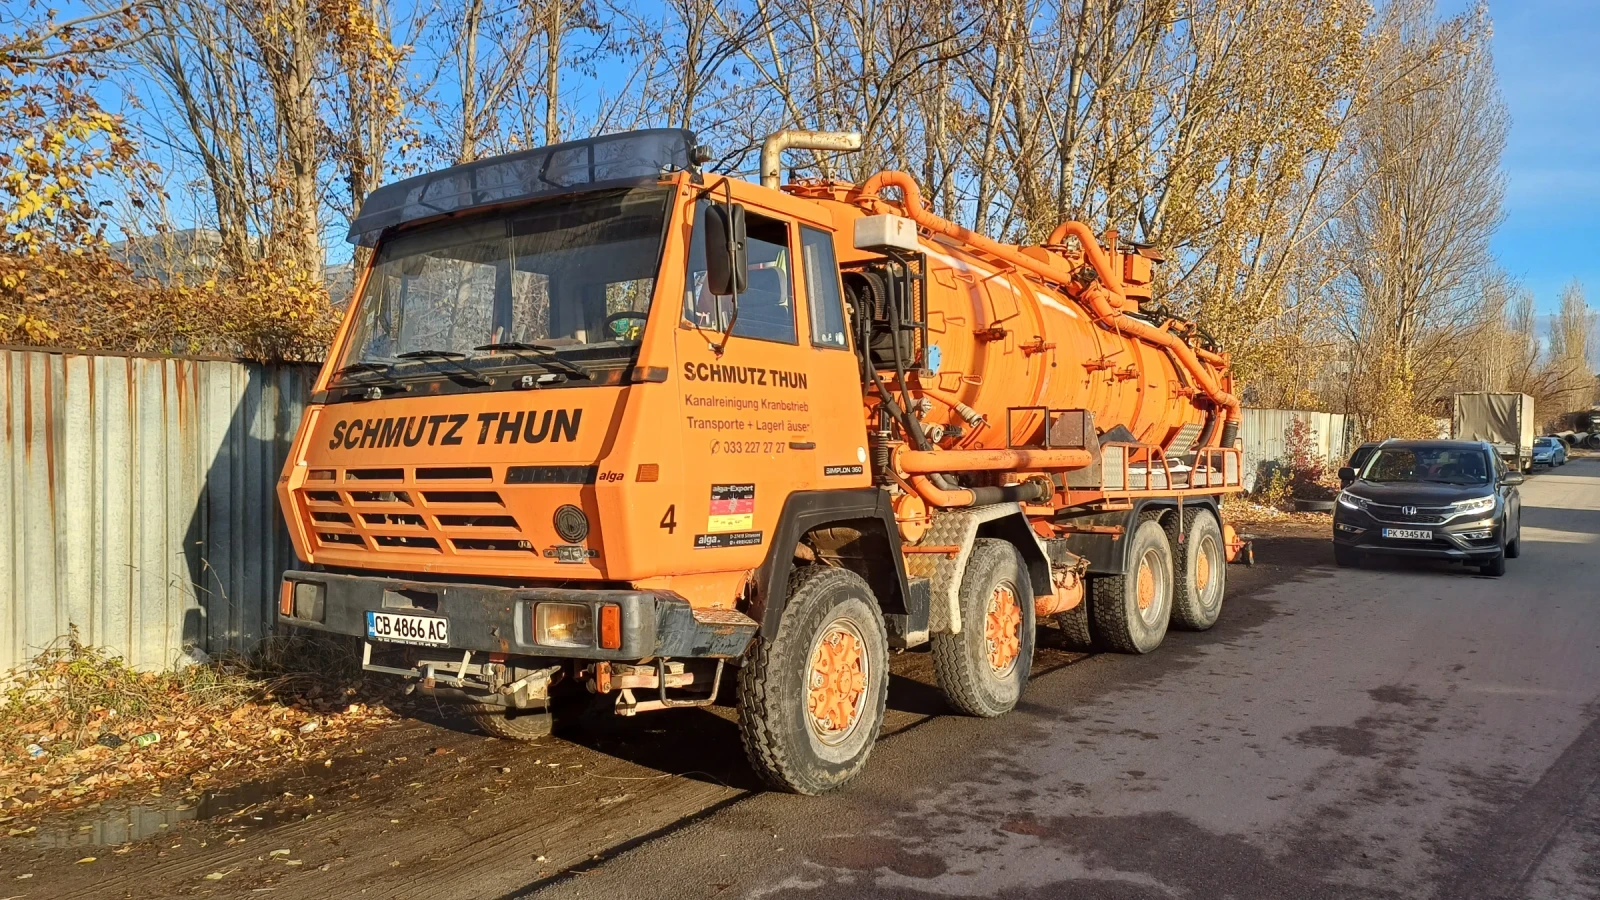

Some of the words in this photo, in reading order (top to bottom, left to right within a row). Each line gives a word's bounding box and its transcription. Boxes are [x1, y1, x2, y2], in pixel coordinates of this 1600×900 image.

[684, 361, 767, 386] SCHMUTZ
[769, 369, 808, 389] THUN
[684, 394, 759, 411] Kanalreinigung
[760, 398, 809, 412] Kranbetrieb
[329, 413, 469, 450] SCHMUTZ
[477, 408, 583, 445] THUN
[686, 416, 745, 432] Transporte
[747, 422, 754, 430] +
[723, 441, 742, 453] 033
[744, 441, 760, 453] 227
[763, 441, 773, 453] 27
[775, 442, 786, 453] 27
[599, 470, 624, 482] alga
[659, 504, 677, 535] 4
[698, 534, 717, 546] alga
[1400, 530, 1419, 538] 9345
[375, 616, 391, 635] CB
[394, 618, 425, 638] 4866
[428, 620, 446, 640] AC
